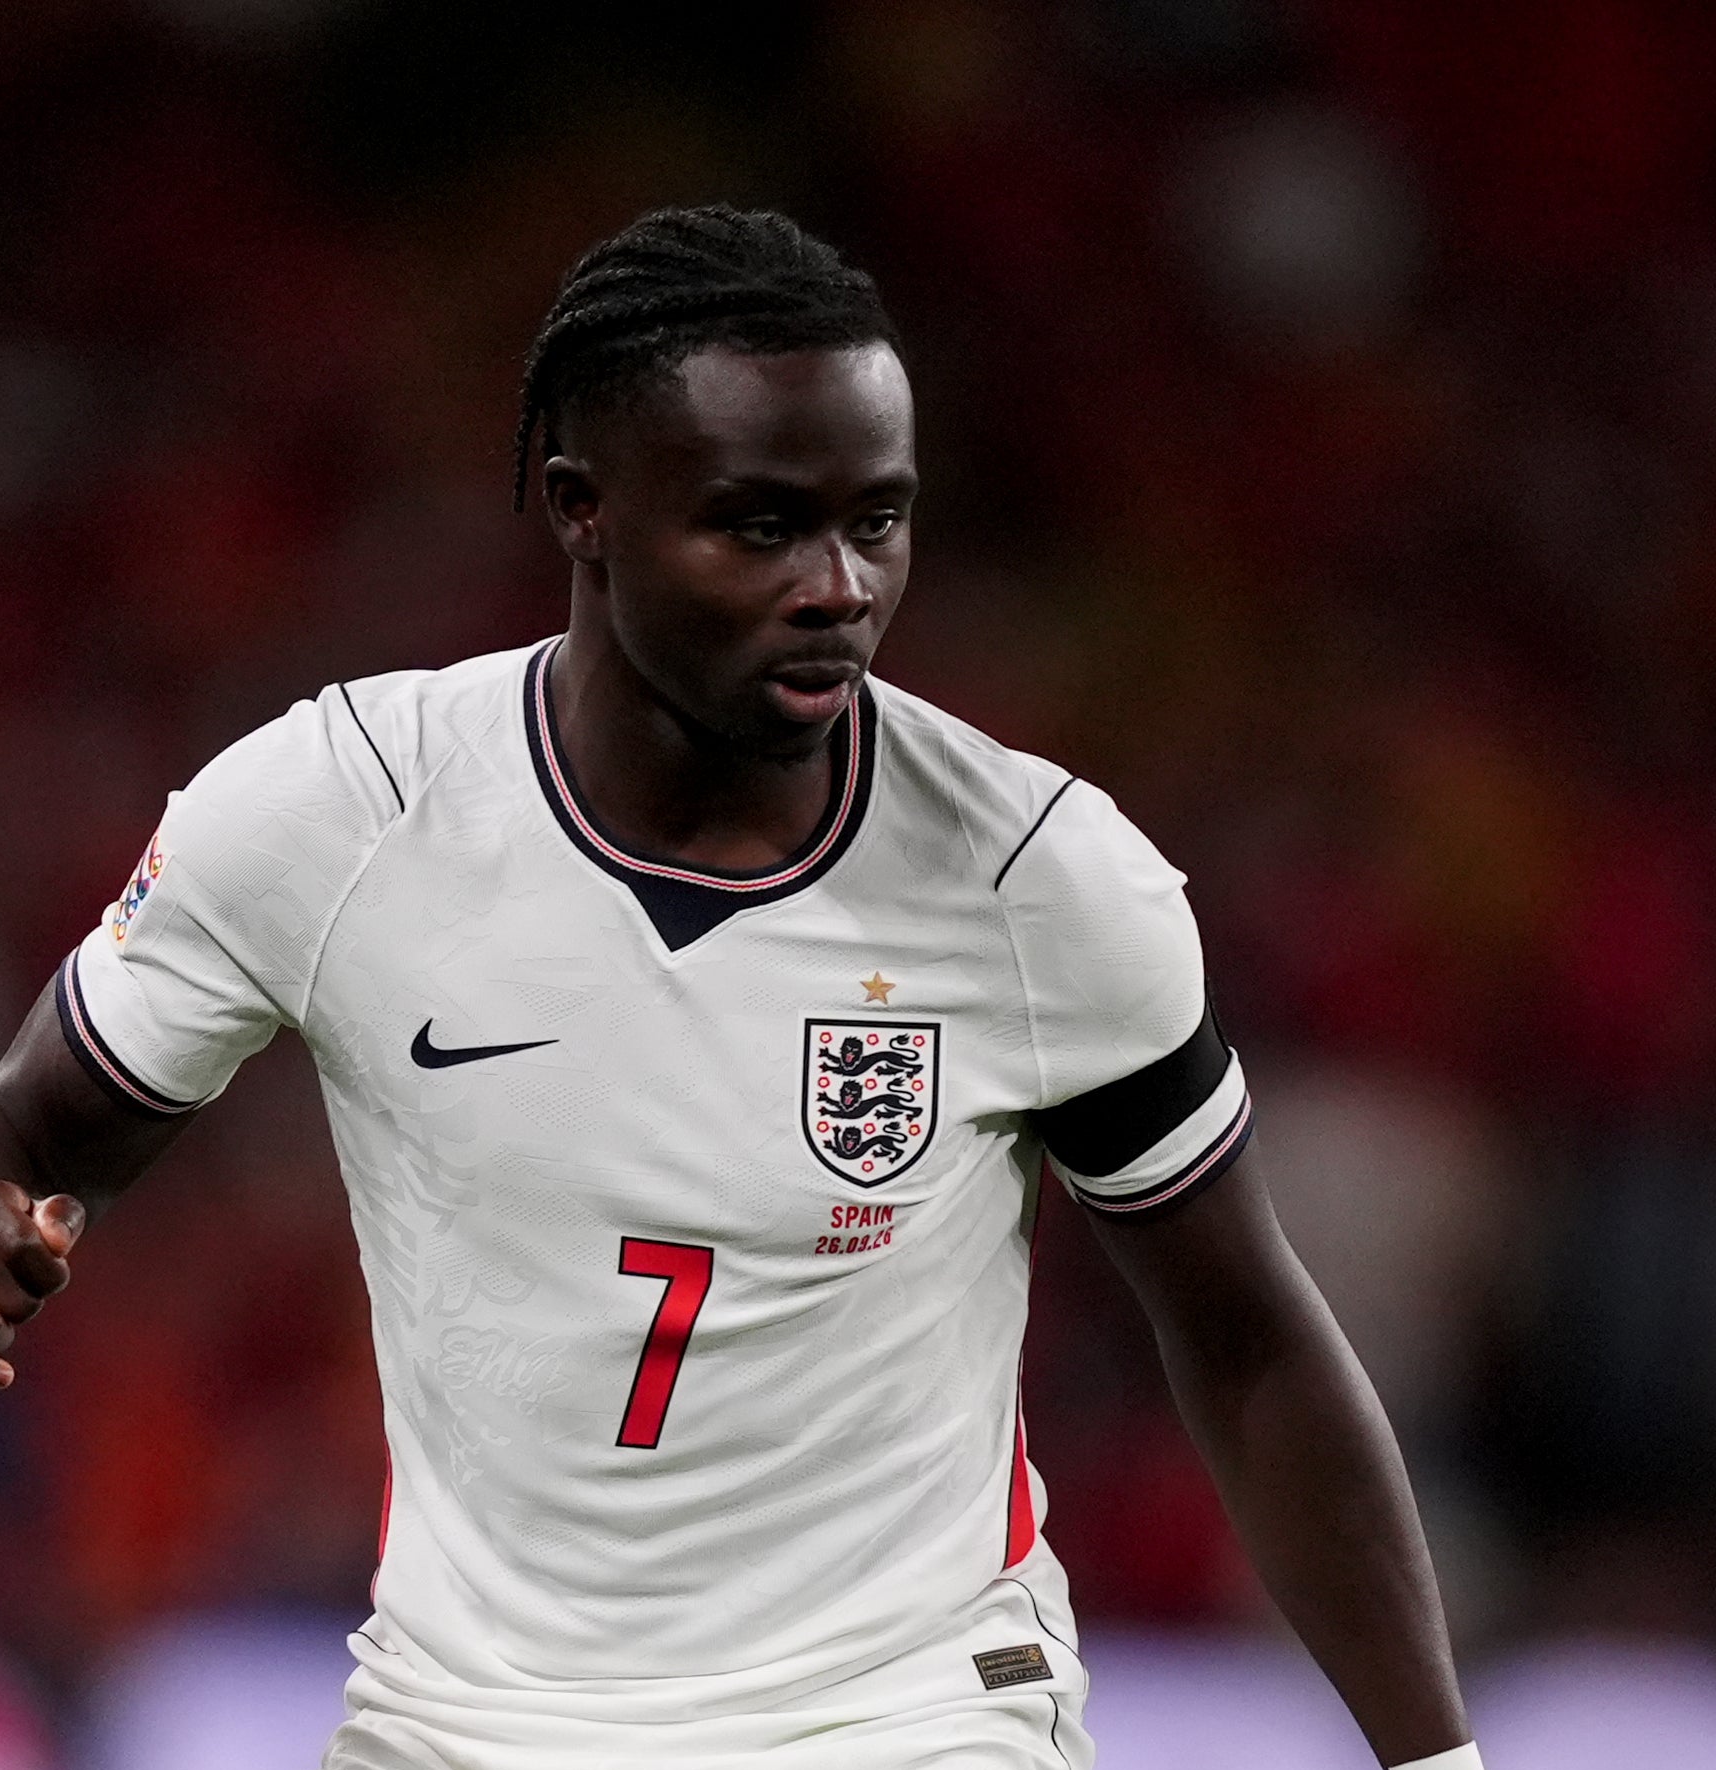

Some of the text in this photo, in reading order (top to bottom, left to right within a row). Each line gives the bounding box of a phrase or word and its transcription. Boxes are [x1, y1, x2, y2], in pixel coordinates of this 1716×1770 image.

[831, 1205, 896, 1229] SPAIN
[815, 1225, 895, 1255] 26.09.26
[615, 1236, 714, 1449] 7
